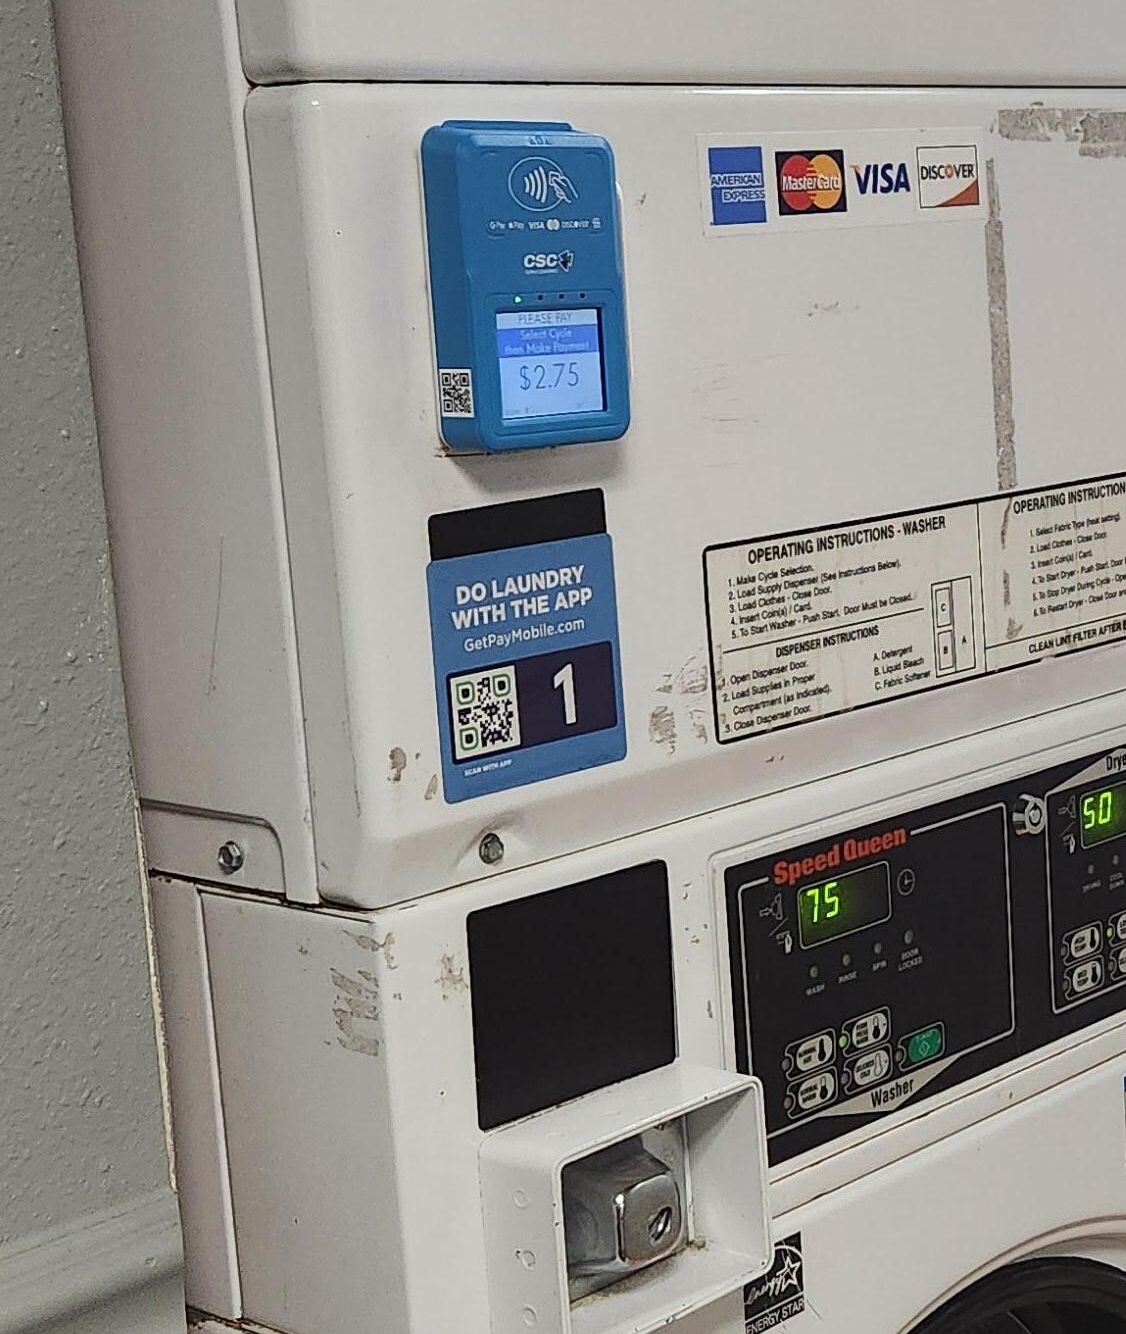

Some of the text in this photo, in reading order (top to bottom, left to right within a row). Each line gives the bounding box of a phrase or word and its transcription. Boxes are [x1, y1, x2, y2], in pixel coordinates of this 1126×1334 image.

[711, 174, 762, 186] AMERICAN
[851, 163, 911, 195] VISA
[921, 164, 975, 181] DISCOVER
[781, 175, 841, 191] MasterCard
[722, 190, 765, 202] EXPRESS
[524, 254, 558, 268] CSC
[518, 311, 572, 325] PLEASE PAY
[520, 328, 573, 340] Select Cycle
[526, 343, 551, 354] Make
[553, 341, 590, 353] Payment
[520, 362, 579, 391] $2.75
[1013, 492, 1066, 515] OPERATING
[1054, 522, 1071, 533] Fabric
[748, 516, 946, 564] OPERATING INSTRUCTIONS WASHER
[1051, 537, 1073, 550] Clothes
[737, 569, 779, 586] Make Cycle
[737, 563, 876, 599] Load Supply Dispenser (See Instructions
[1060, 568, 1076, 581] Dryer
[456, 565, 585, 605] DO LAUNDRY
[1060, 579, 1095, 596] Dryer During
[738, 585, 832, 612] Load Clothes Close Door.
[1069, 598, 1084, 610] Dryer
[451, 587, 593, 630] WITH THE APP
[739, 605, 788, 624] Insert Coin(s)
[740, 596, 887, 638] To Start Washer Push Door Must be
[464, 618, 585, 652] GetPayMobile.com
[775, 625, 880, 658] DISPENSER INSTRUCTIONS
[961, 635, 967, 645] A
[1028, 639, 1054, 654] CLEAN
[1055, 632, 1072, 647] LINT
[1073, 628, 1097, 642] FILTER
[1098, 620, 1122, 636] AFTER
[881, 644, 913, 661] Detergent
[730, 659, 809, 686] Open Dispenser Door.
[882, 657, 925, 676] Liquid Bleach
[731, 688, 750, 701] Load
[751, 679, 782, 696] Supplies
[792, 673, 816, 688] Proper
[884, 669, 931, 689] Fabric Softener
[553, 663, 577, 726] 1
[733, 696, 782, 717] Compartment
[734, 710, 792, 732] Close Dispenser
[1083, 791, 1112, 829] 50
[773, 828, 907, 885] Speed Queen
[806, 881, 839, 923] 75
[898, 956, 923, 971] LOCKED
[901, 948, 919, 960] DOOR
[872, 960, 887, 971] SPIN
[838, 971, 858, 984] RINSE
[806, 984, 825, 996] WASH
[870, 1079, 914, 1108] Washer
[781, 1297, 805, 1318] STAR
